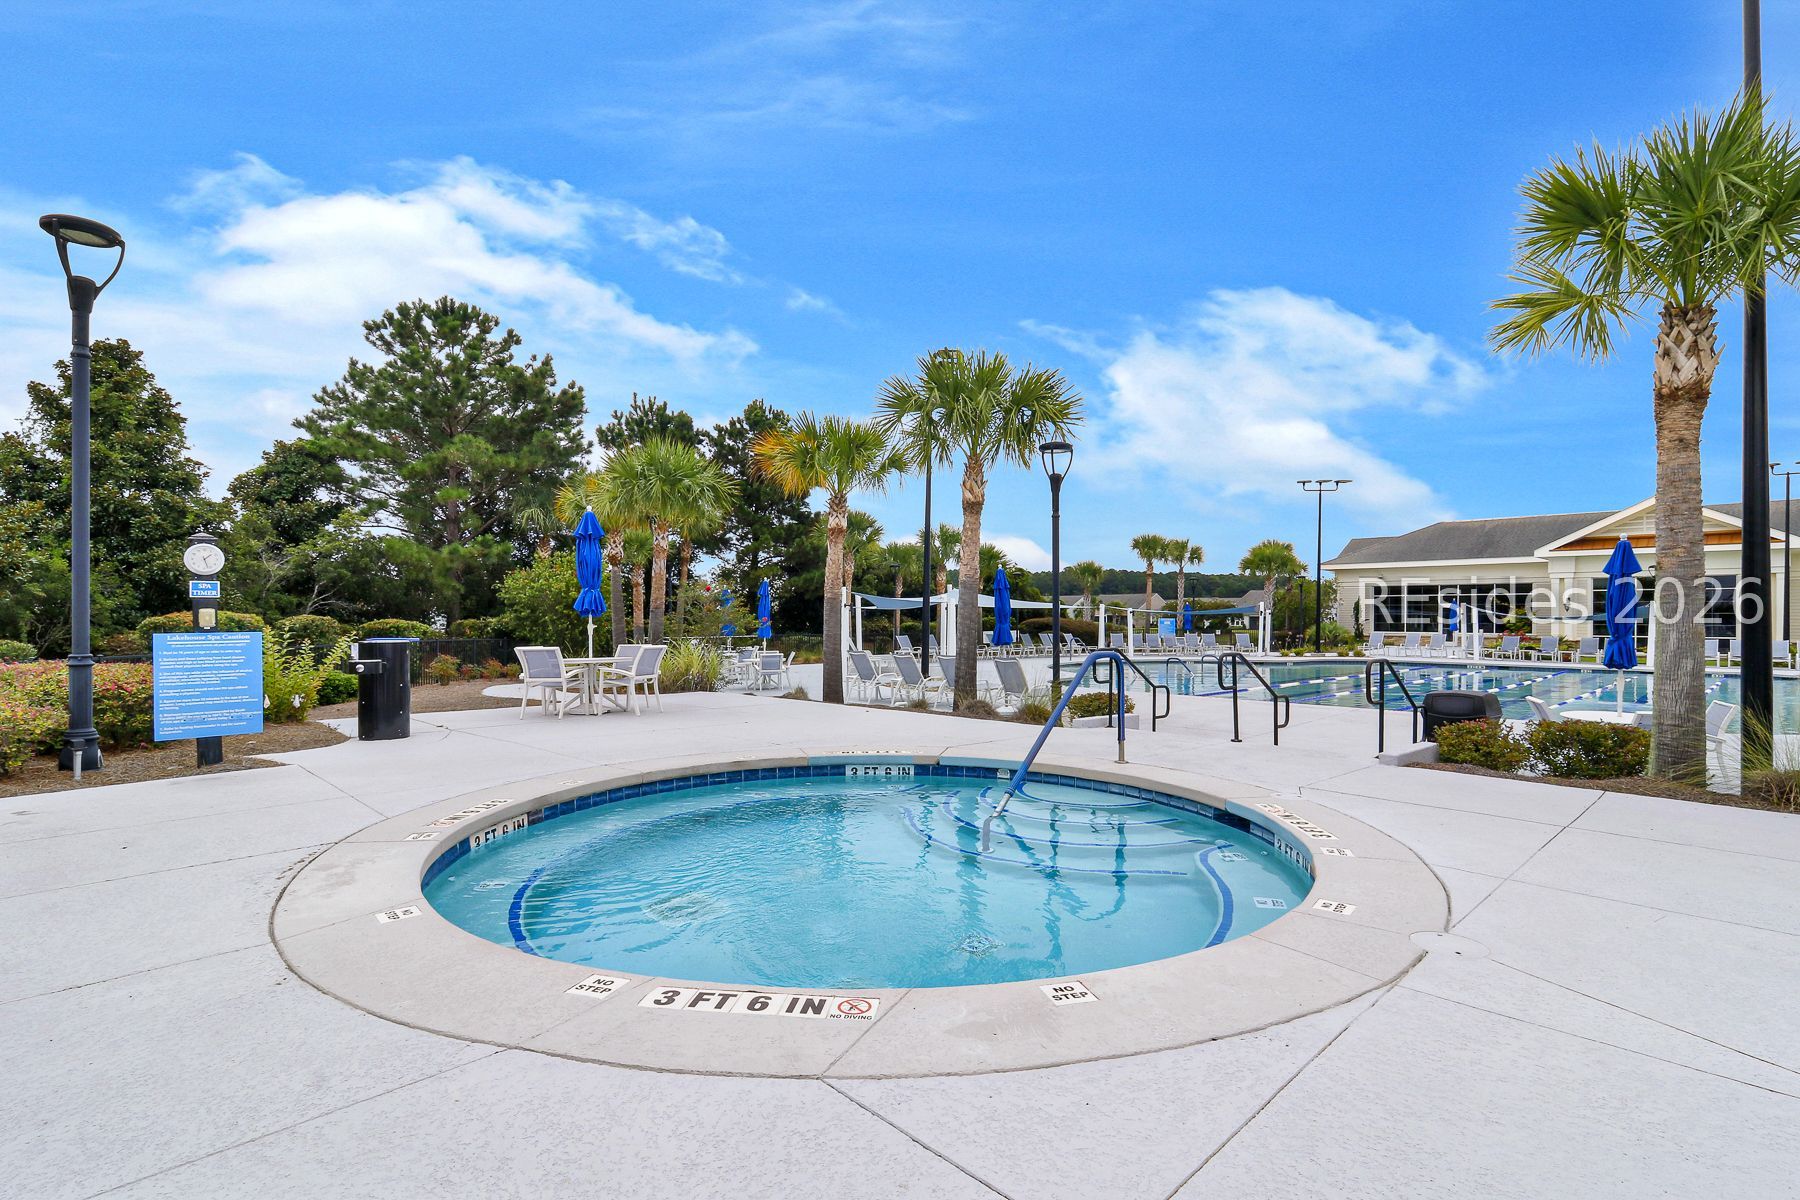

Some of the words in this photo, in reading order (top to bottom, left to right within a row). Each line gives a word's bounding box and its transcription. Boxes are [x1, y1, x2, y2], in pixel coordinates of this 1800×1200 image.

[850, 766, 859, 776] 3
[863, 766, 879, 776] FT
[897, 766, 911, 776] IN
[484, 828, 497, 843] FT
[512, 818, 525, 831] IN
[593, 978, 615, 986] NO
[575, 984, 612, 994] STEP
[1052, 985, 1075, 993] NO
[1052, 991, 1088, 1001] STEP
[653, 990, 681, 1006] 3
[687, 992, 738, 1009] FT
[746, 995, 773, 1012] 6
[785, 997, 827, 1015] IN
